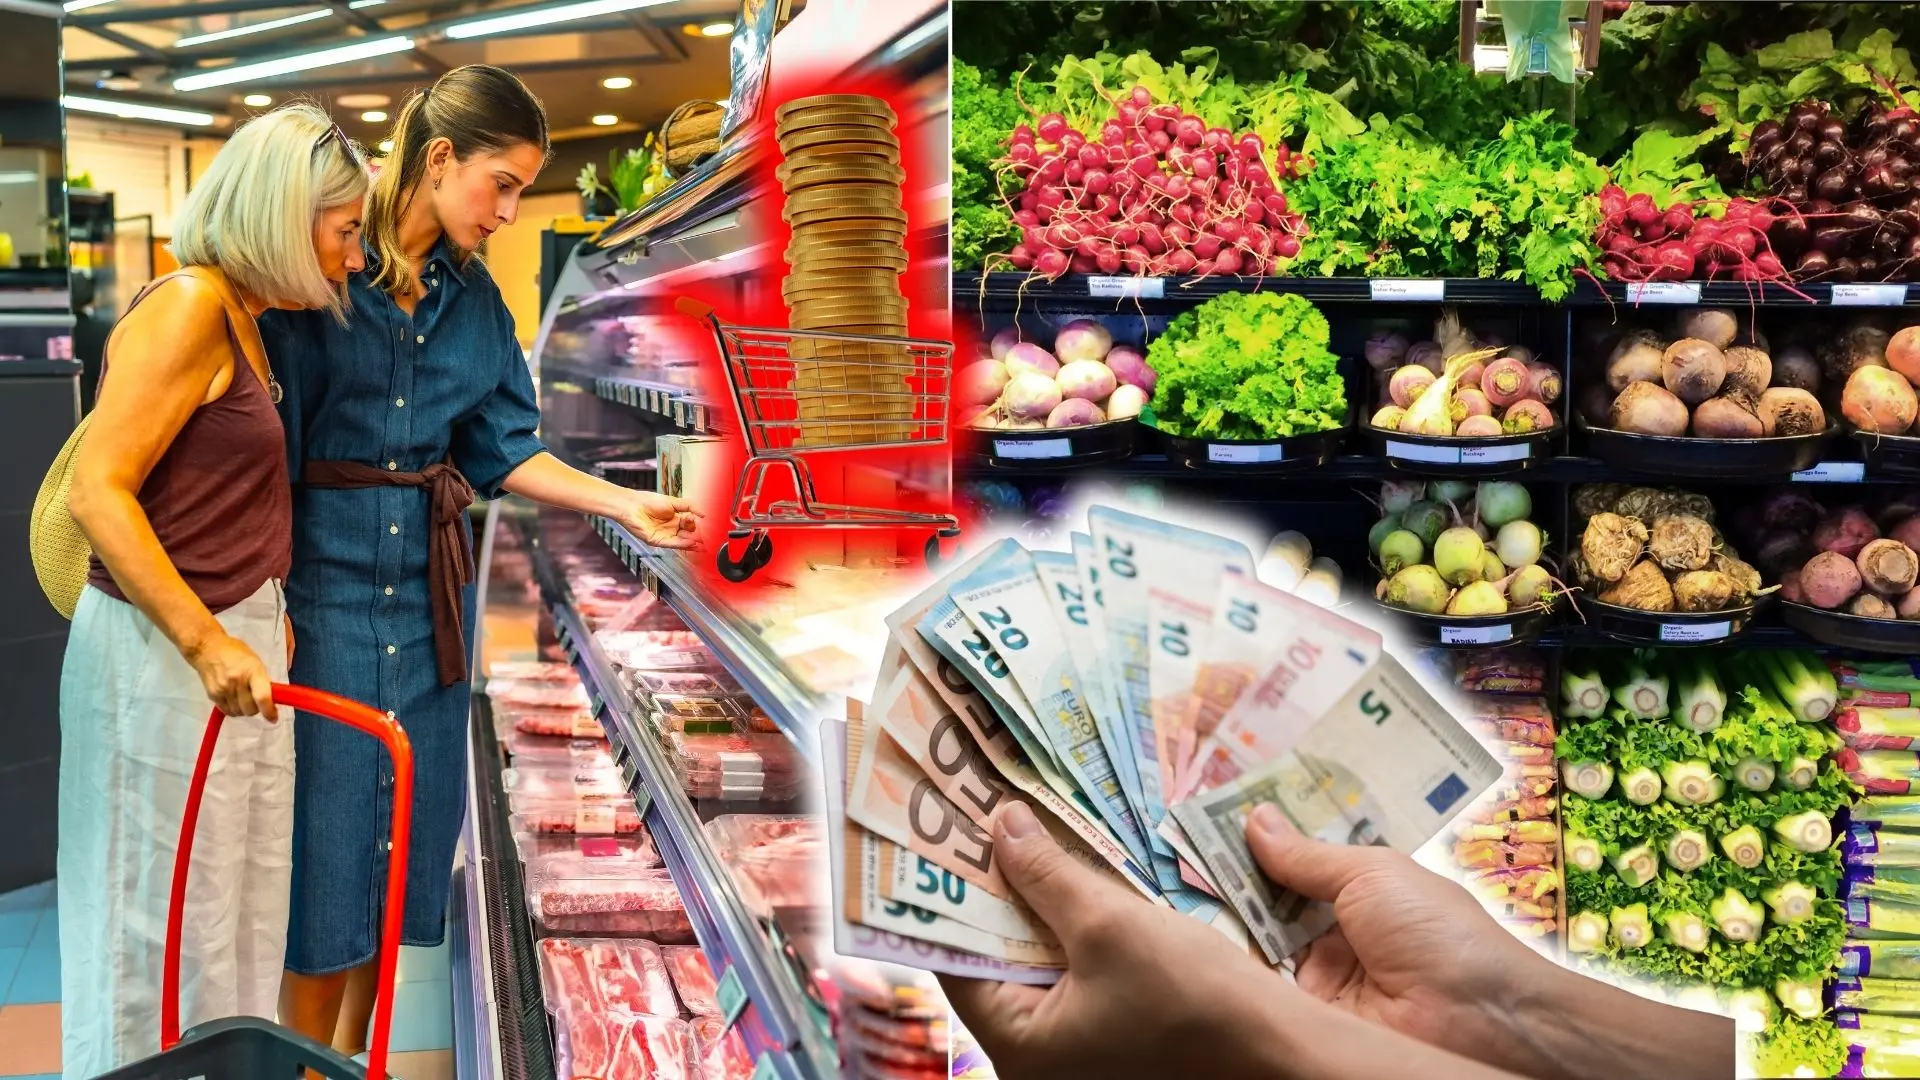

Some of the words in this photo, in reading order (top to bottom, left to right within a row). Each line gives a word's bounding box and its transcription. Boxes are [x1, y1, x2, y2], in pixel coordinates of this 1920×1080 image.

[1104, 535, 1137, 578] 20
[978, 606, 1029, 651] 20
[1226, 598, 1259, 633] 10
[962, 629, 1010, 679] 20
[1160, 620, 1190, 657] 10
[1061, 688, 1092, 735] EURO
[1359, 690, 1391, 725] 5
[915, 854, 966, 905] 50
